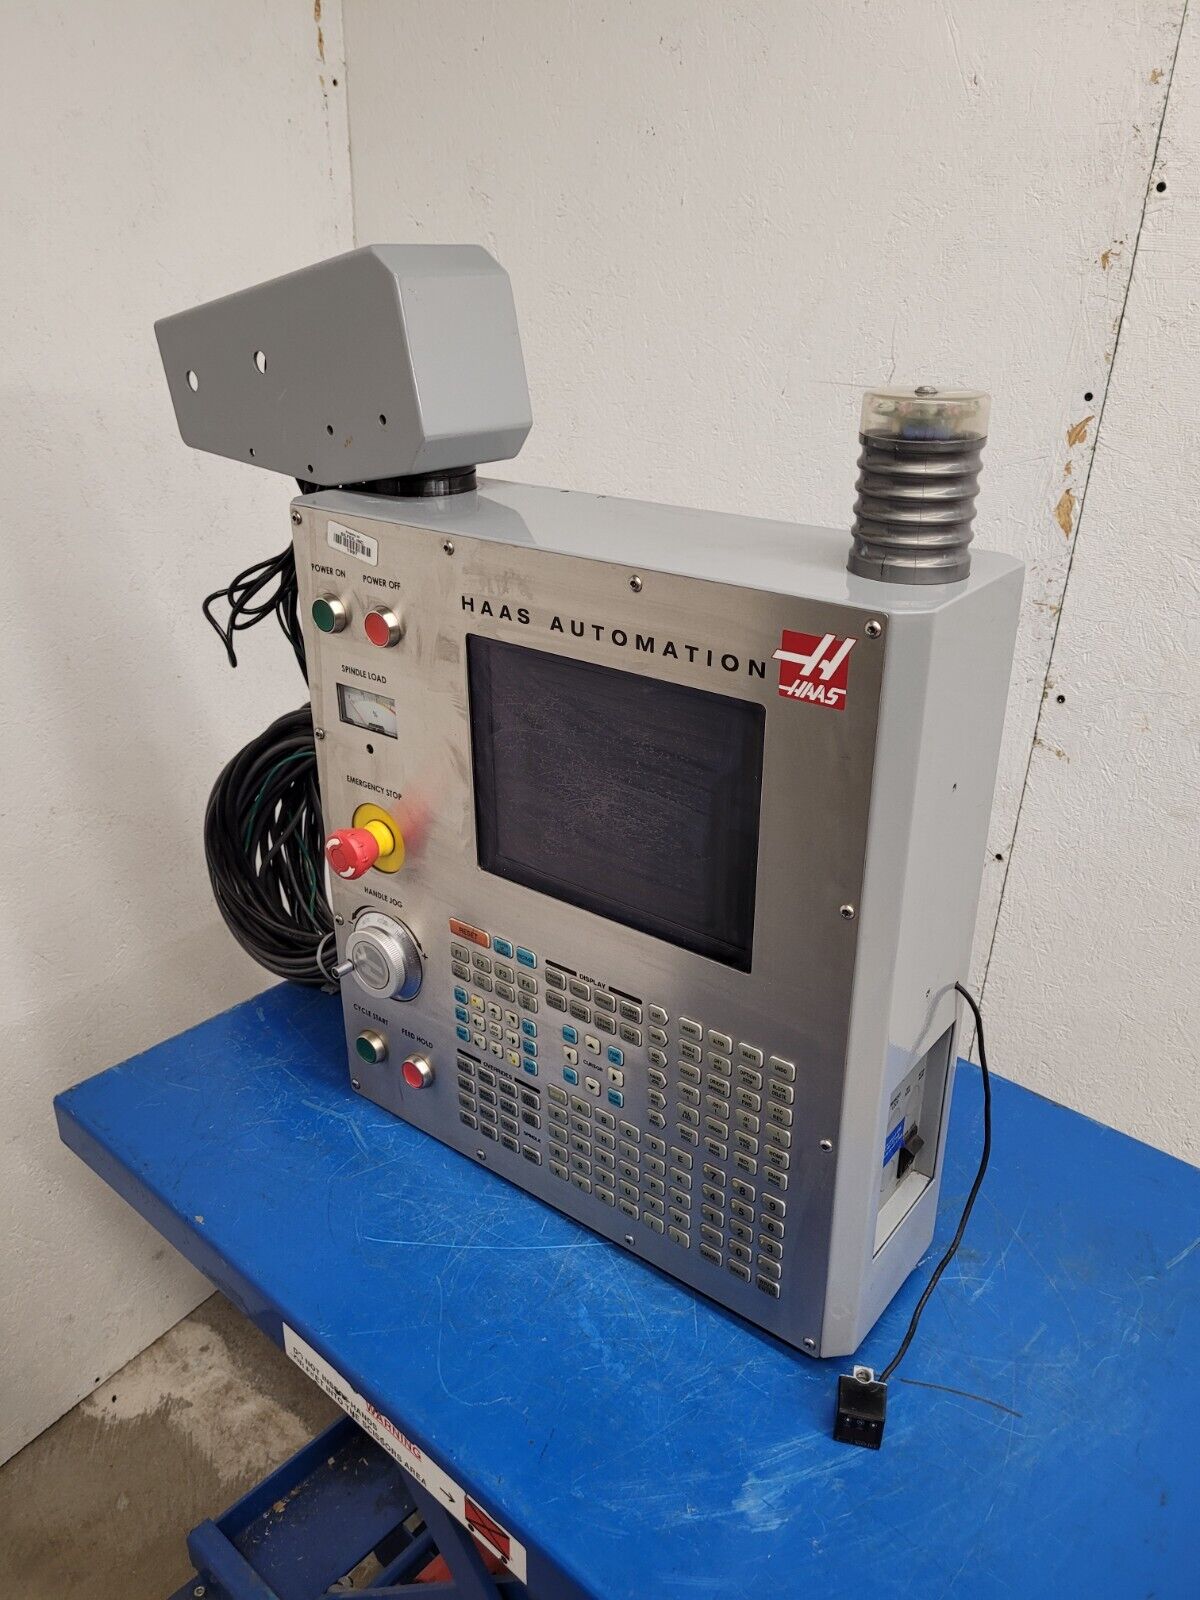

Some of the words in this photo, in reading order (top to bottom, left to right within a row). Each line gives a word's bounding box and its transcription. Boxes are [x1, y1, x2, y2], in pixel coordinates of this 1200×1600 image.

[311, 563, 334, 575] POWER
[335, 568, 346, 578] ON
[363, 575, 386, 587] POWER
[388, 580, 400, 590] OFF
[461, 596, 530, 624] HAAS
[550, 616, 766, 679] AUTOMATION
[341, 664, 367, 678] SPINDLE
[368, 672, 387, 684] LOAD
[778, 679, 847, 705] HAAS
[346, 774, 385, 794] EMERGENCY
[386, 789, 402, 800] STOP
[364, 886, 388, 902] HANDLE
[390, 896, 403, 908] JOG
[458, 926, 478, 940] RESET
[476, 959, 484, 967] F2
[498, 969, 506, 978] F3
[522, 980, 530, 988] F4
[580, 974, 606, 989] DISPLAY
[354, 1004, 371, 1018] CYCLE
[372, 1012, 388, 1026] START
[402, 1028, 416, 1040] FEED
[416, 1036, 434, 1049] HOLD
[712, 1039, 724, 1048] ALTER
[742, 1051, 756, 1060] DELETE
[583, 1060, 603, 1072] CURSOR
[774, 1064, 788, 1074] UNDO
[483, 1062, 512, 1080] OVERRIDES
[740, 1069, 757, 1080] OPTION
[772, 1090, 787, 1100] DELETE
[577, 1104, 582, 1112] A
[601, 1136, 607, 1144] H
[652, 1142, 657, 1150] D
[678, 1155, 684, 1163] E
[554, 1168, 560, 1176] X
[626, 1168, 632, 1176] O
[710, 1171, 716, 1180] 7
[602, 1174, 606, 1182] T
[676, 1176, 682, 1184] K
[625, 1188, 631, 1196] U
[740, 1186, 746, 1196] 8
[650, 1200, 656, 1208] V
[676, 1196, 682, 1204] Q
[769, 1202, 776, 1211] 9
[738, 1208, 744, 1216] 5
[674, 1214, 682, 1222] W
[768, 1222, 774, 1232] 6
[738, 1228, 744, 1236] 2
[736, 1248, 742, 1257] 0
[766, 1244, 773, 1253] 3
[305, 1358, 320, 1375] NOT
[351, 1402, 378, 1431] HANDS
[326, 1384, 343, 1404] INTO
[345, 1402, 360, 1420] THE
[362, 1420, 402, 1462] SCISSORS
[404, 1462, 426, 1486] AREA
[366, 1402, 422, 1462] WARNING
